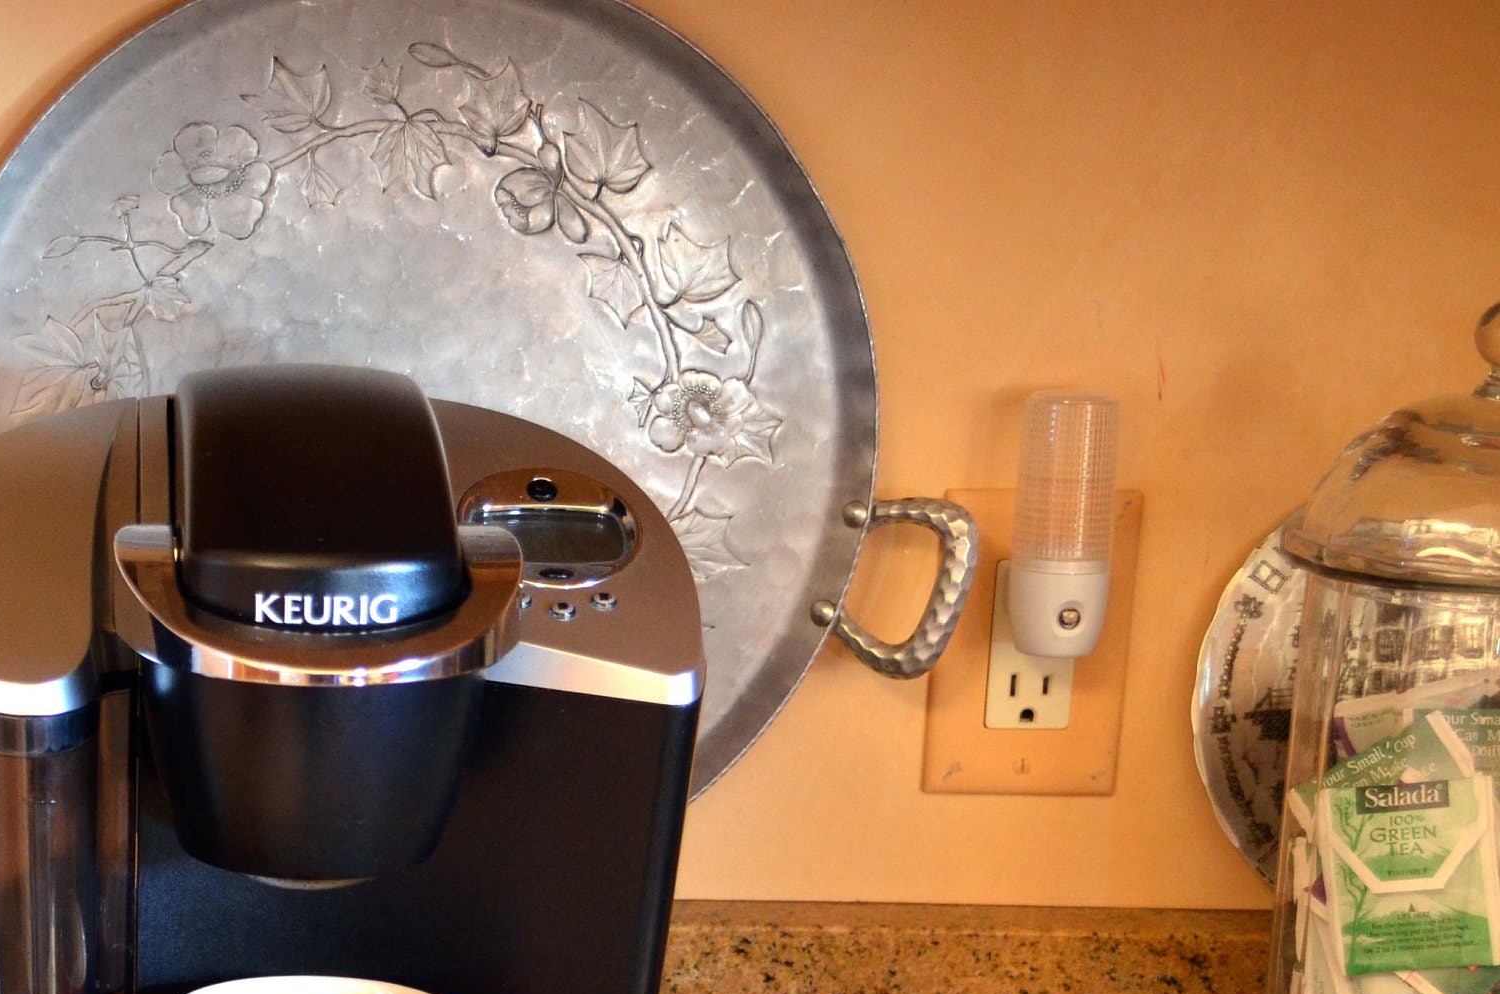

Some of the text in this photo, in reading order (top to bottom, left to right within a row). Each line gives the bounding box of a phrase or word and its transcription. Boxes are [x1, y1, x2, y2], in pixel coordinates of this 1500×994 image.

[254, 592, 399, 626] KEURIG
[1443, 711, 1500, 726] our Sma
[1347, 746, 1386, 774] Small
[1393, 734, 1417, 754] Cup
[1363, 785, 1441, 809] Salada
[1388, 814, 1425, 826] 100%
[1369, 824, 1437, 843] GREEN
[1385, 841, 1424, 857] TEA
